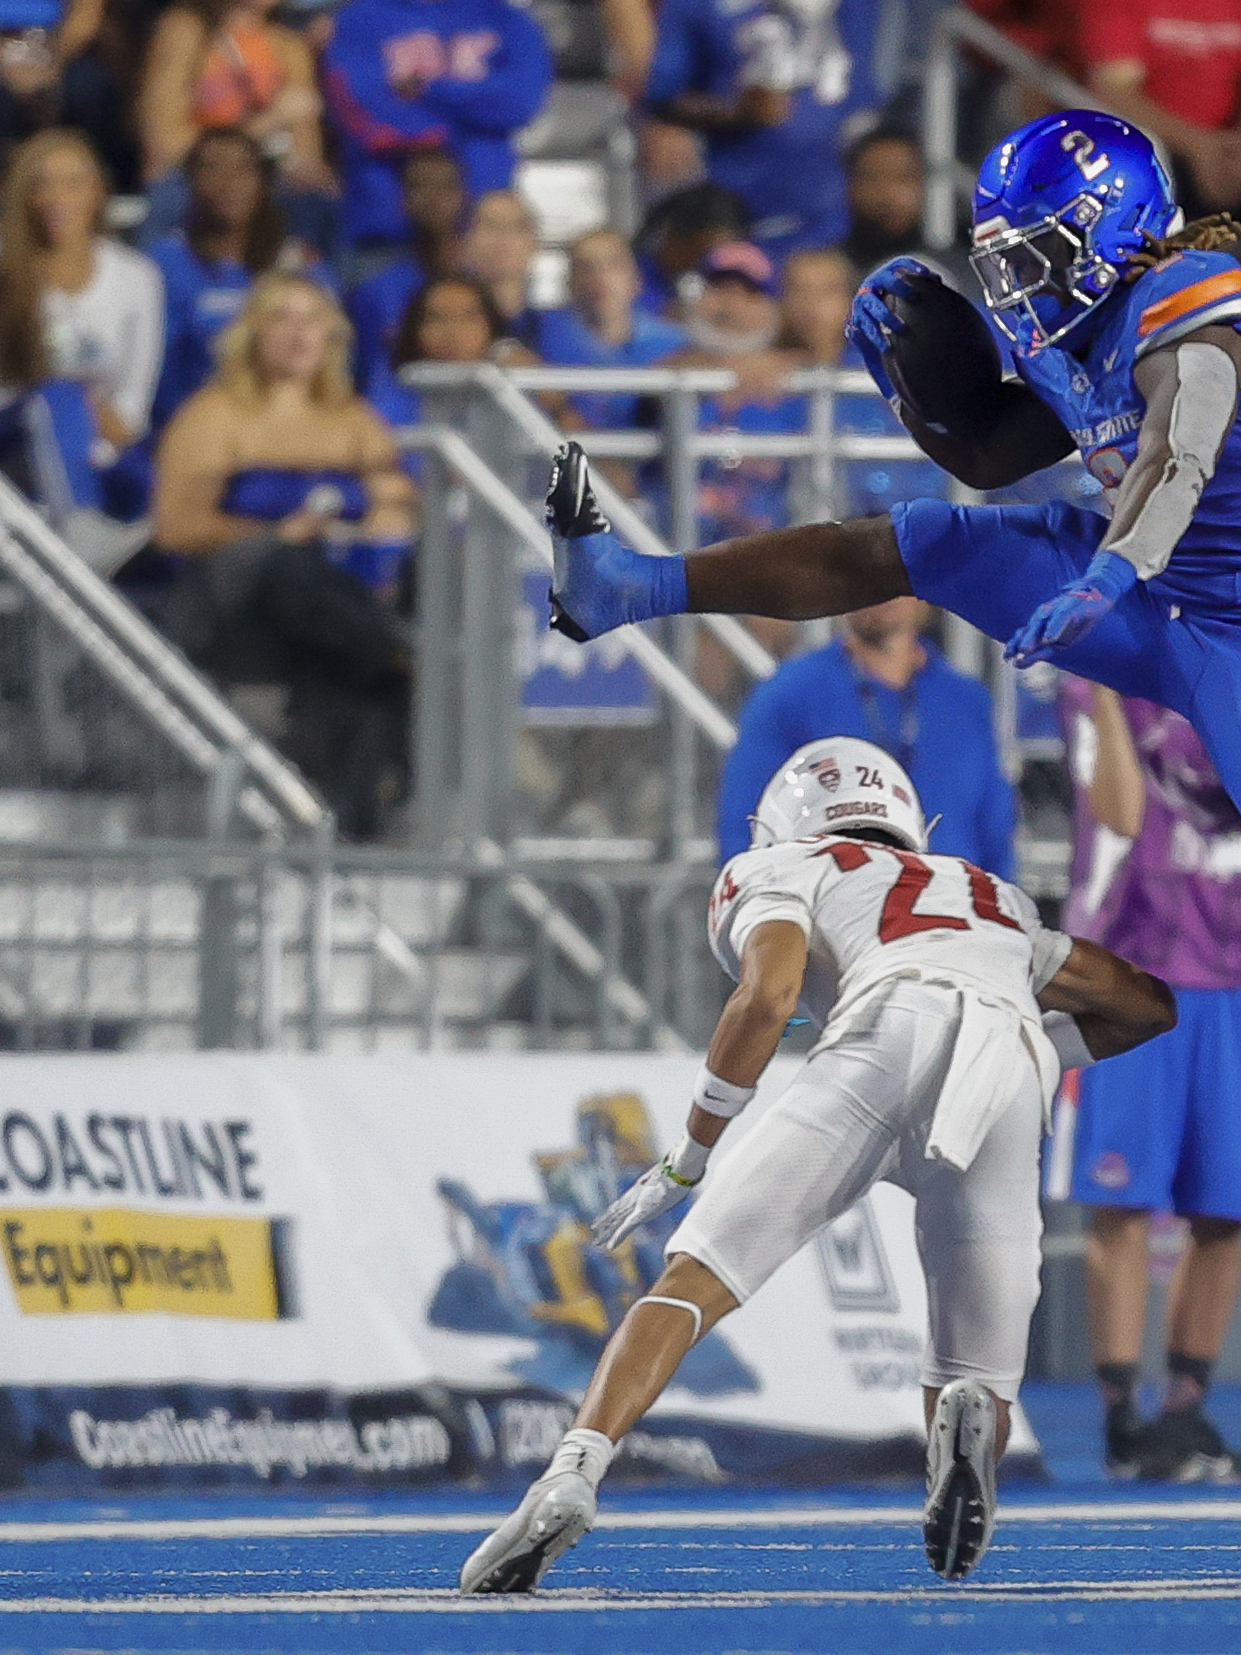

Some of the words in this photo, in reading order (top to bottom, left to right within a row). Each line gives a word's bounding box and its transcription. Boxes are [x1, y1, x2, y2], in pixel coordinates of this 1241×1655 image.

[1061, 129, 1111, 181] 2
[855, 766, 884, 790] 24
[825, 801, 888, 821] COUGARS
[0, 1110, 263, 1202] OASTLINE
[4, 1218, 233, 1308] Equipment
